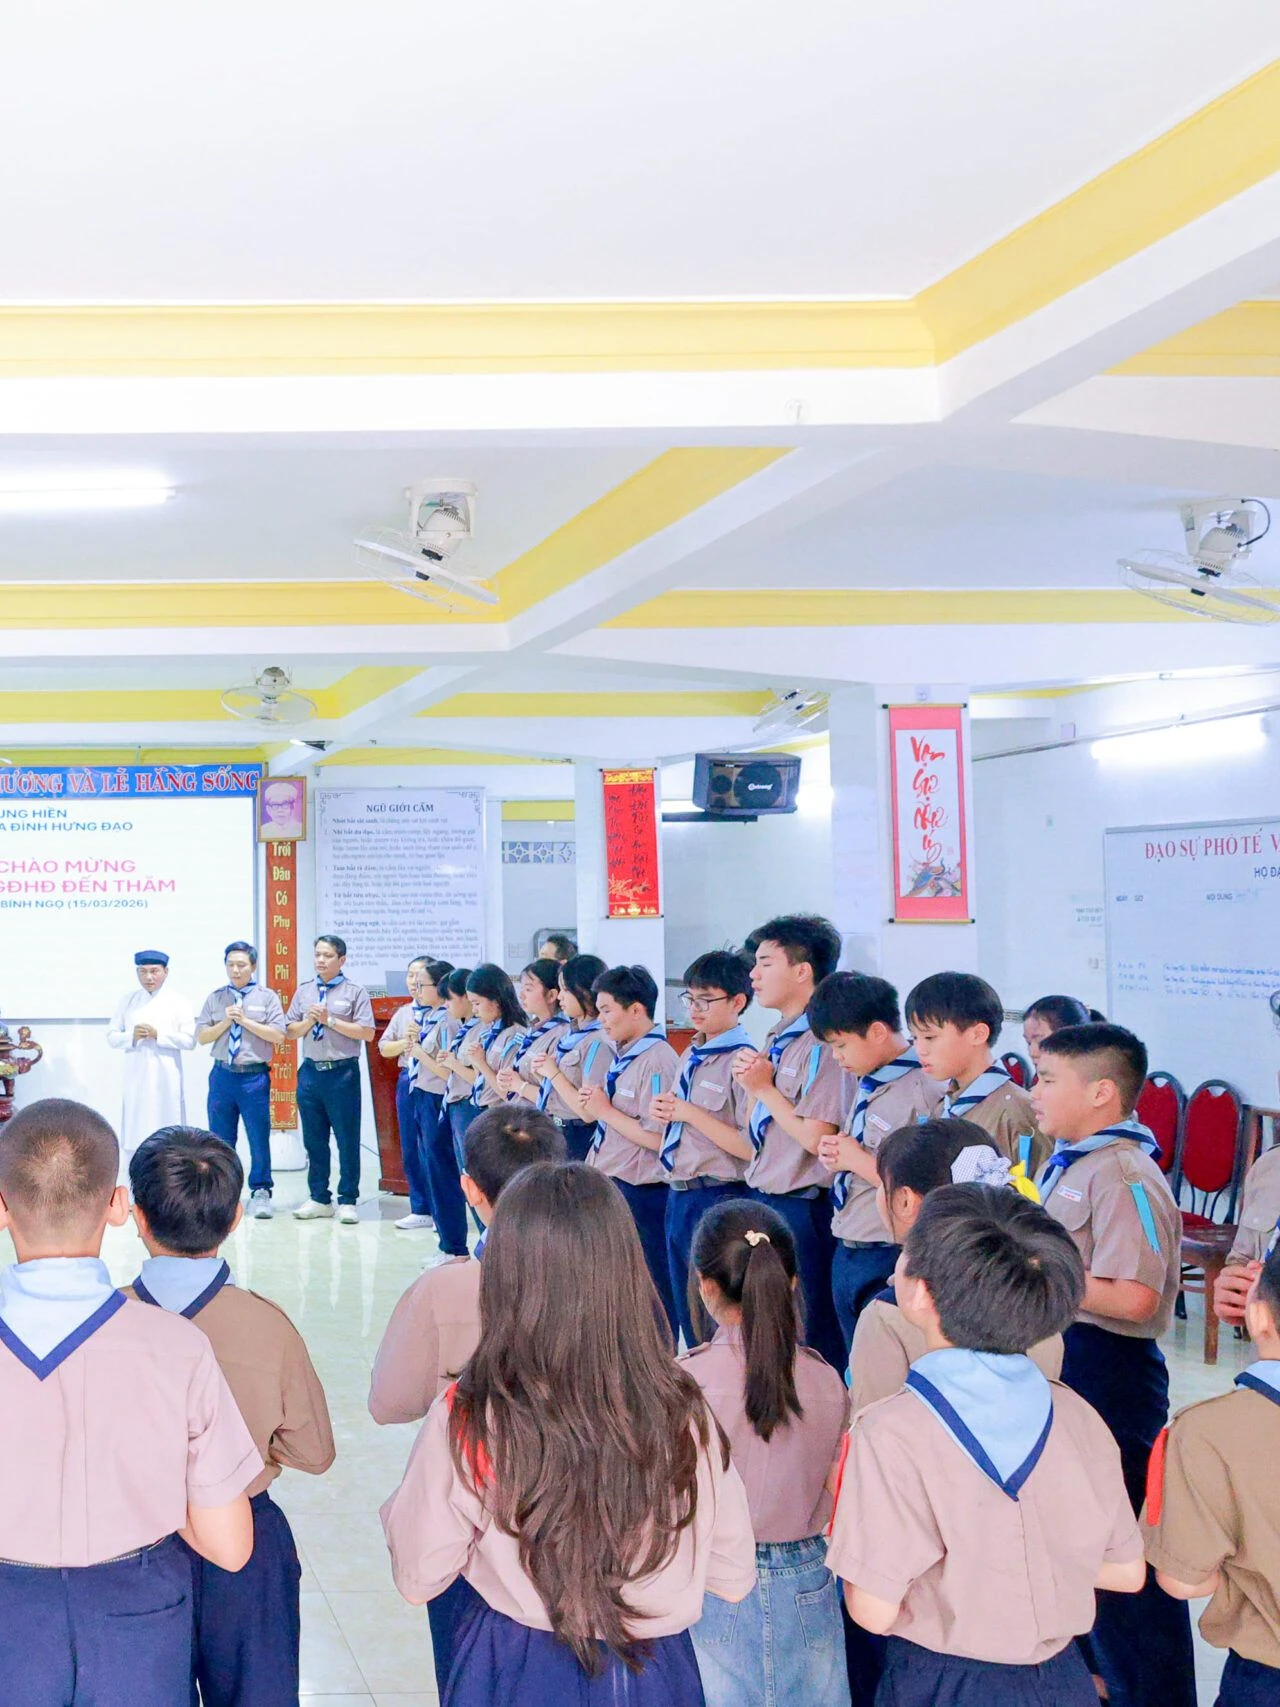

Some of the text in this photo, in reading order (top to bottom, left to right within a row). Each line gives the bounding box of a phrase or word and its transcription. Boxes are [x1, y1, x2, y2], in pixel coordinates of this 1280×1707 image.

[68, 769, 95, 793] VÀ
[101, 768, 130, 793] LẼ
[202, 765, 259, 791] SỐNG
[32, 807, 67, 819] HIỀN
[366, 802, 387, 813] NGŨ
[389, 802, 411, 813] GIỚI
[11, 820, 47, 832] ĐÌNH
[52, 821, 97, 832] HƯNG
[101, 821, 133, 833] ĐẠO
[1145, 841, 1176, 863] ĐẠO
[1241, 827, 1263, 854] TẾ
[65, 857, 136, 874] MỪNG
[272, 865, 290, 881] Đâu
[1254, 866, 1268, 880] HỌ
[62, 875, 108, 893] ĐẾN
[113, 875, 176, 893] THĂM
[0, 898, 32, 909] BÍNH
[35, 899, 64, 910] NGỌ
[67, 899, 148, 909] (15/03/2026)
[275, 889, 288, 906] Có
[273, 915, 291, 930] Phụ
[275, 940, 288, 956] Úc
[274, 964, 289, 980] Phi
[269, 1088, 297, 1104] Chung
